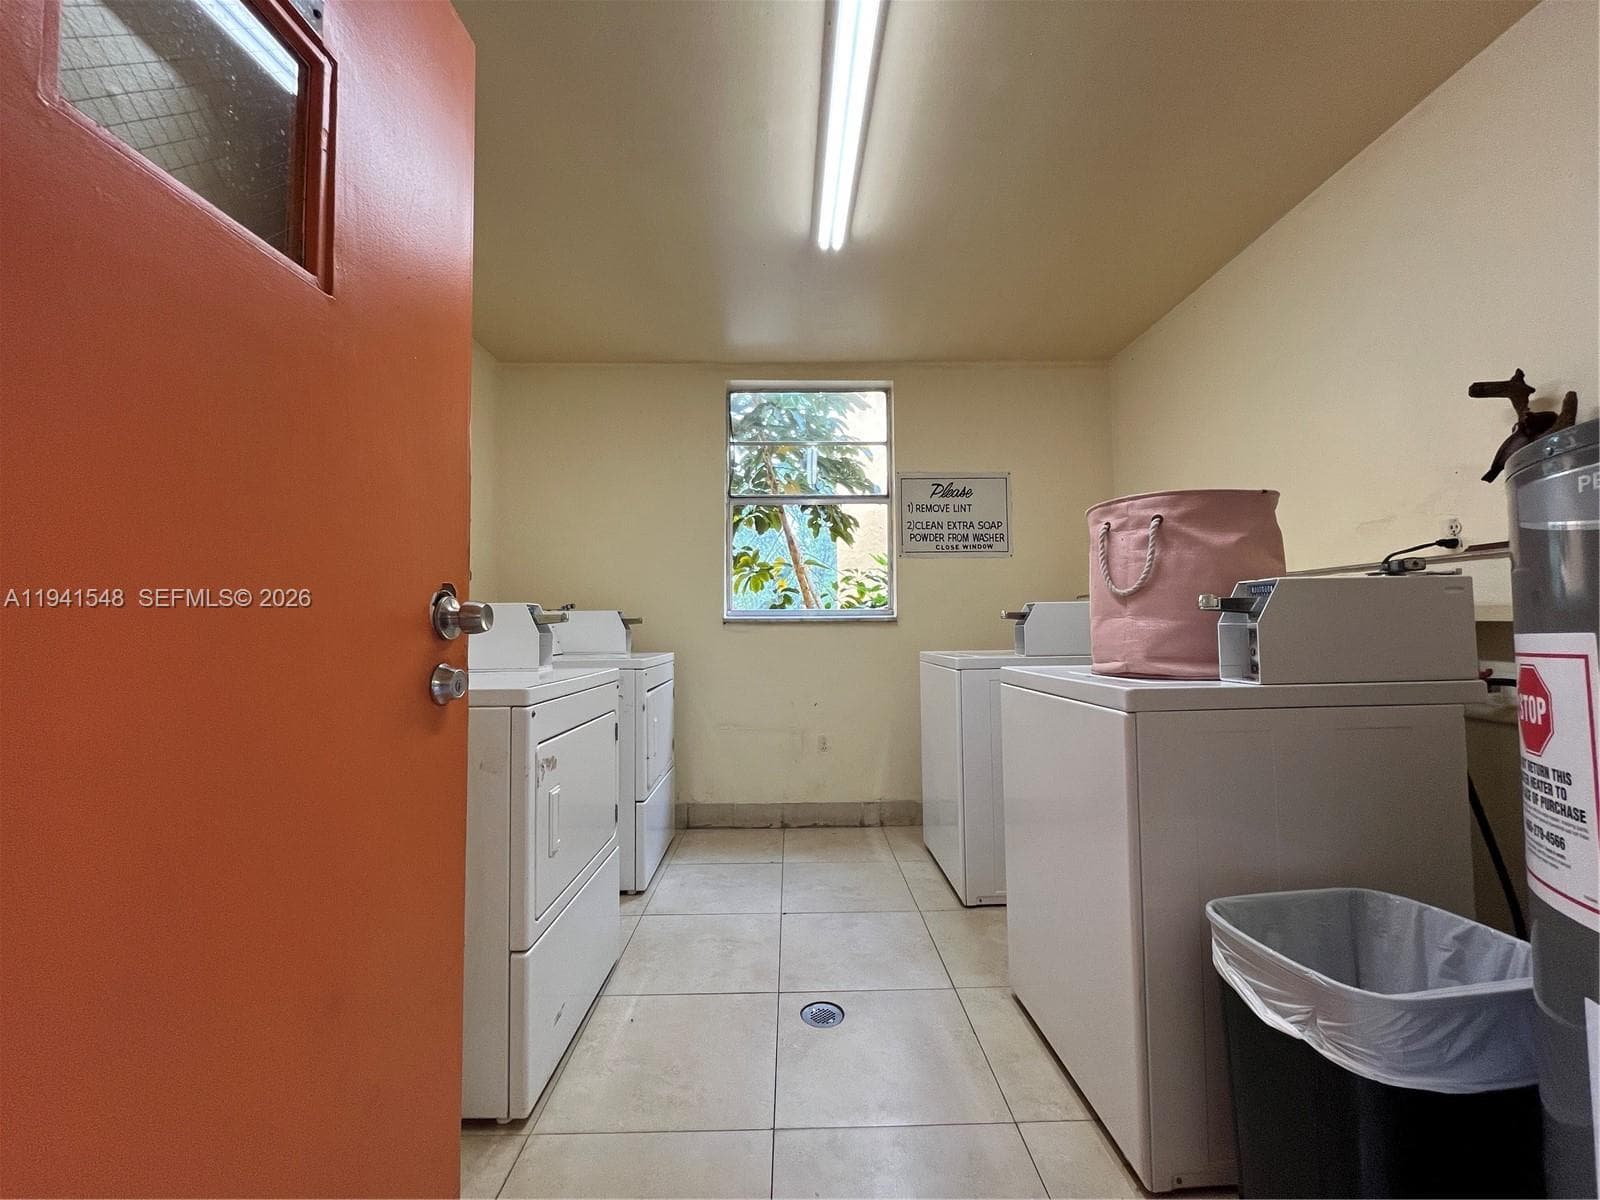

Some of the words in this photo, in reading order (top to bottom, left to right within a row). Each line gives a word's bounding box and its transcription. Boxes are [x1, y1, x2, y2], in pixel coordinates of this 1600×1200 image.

[930, 482, 974, 499] Please
[915, 504, 950, 513] REMOVE
[953, 504, 972, 513] LINT
[947, 521, 975, 530] EXTRA
[978, 521, 1003, 530] SOAP
[909, 533, 945, 542] POWDER
[947, 533, 969, 542] FROM
[973, 533, 1005, 543] WASHER
[1552, 768, 1572, 786] THIS
[1530, 776, 1554, 796] HEATER
[1555, 785, 1567, 801] TO
[1540, 796, 1587, 824] PURCHASE
